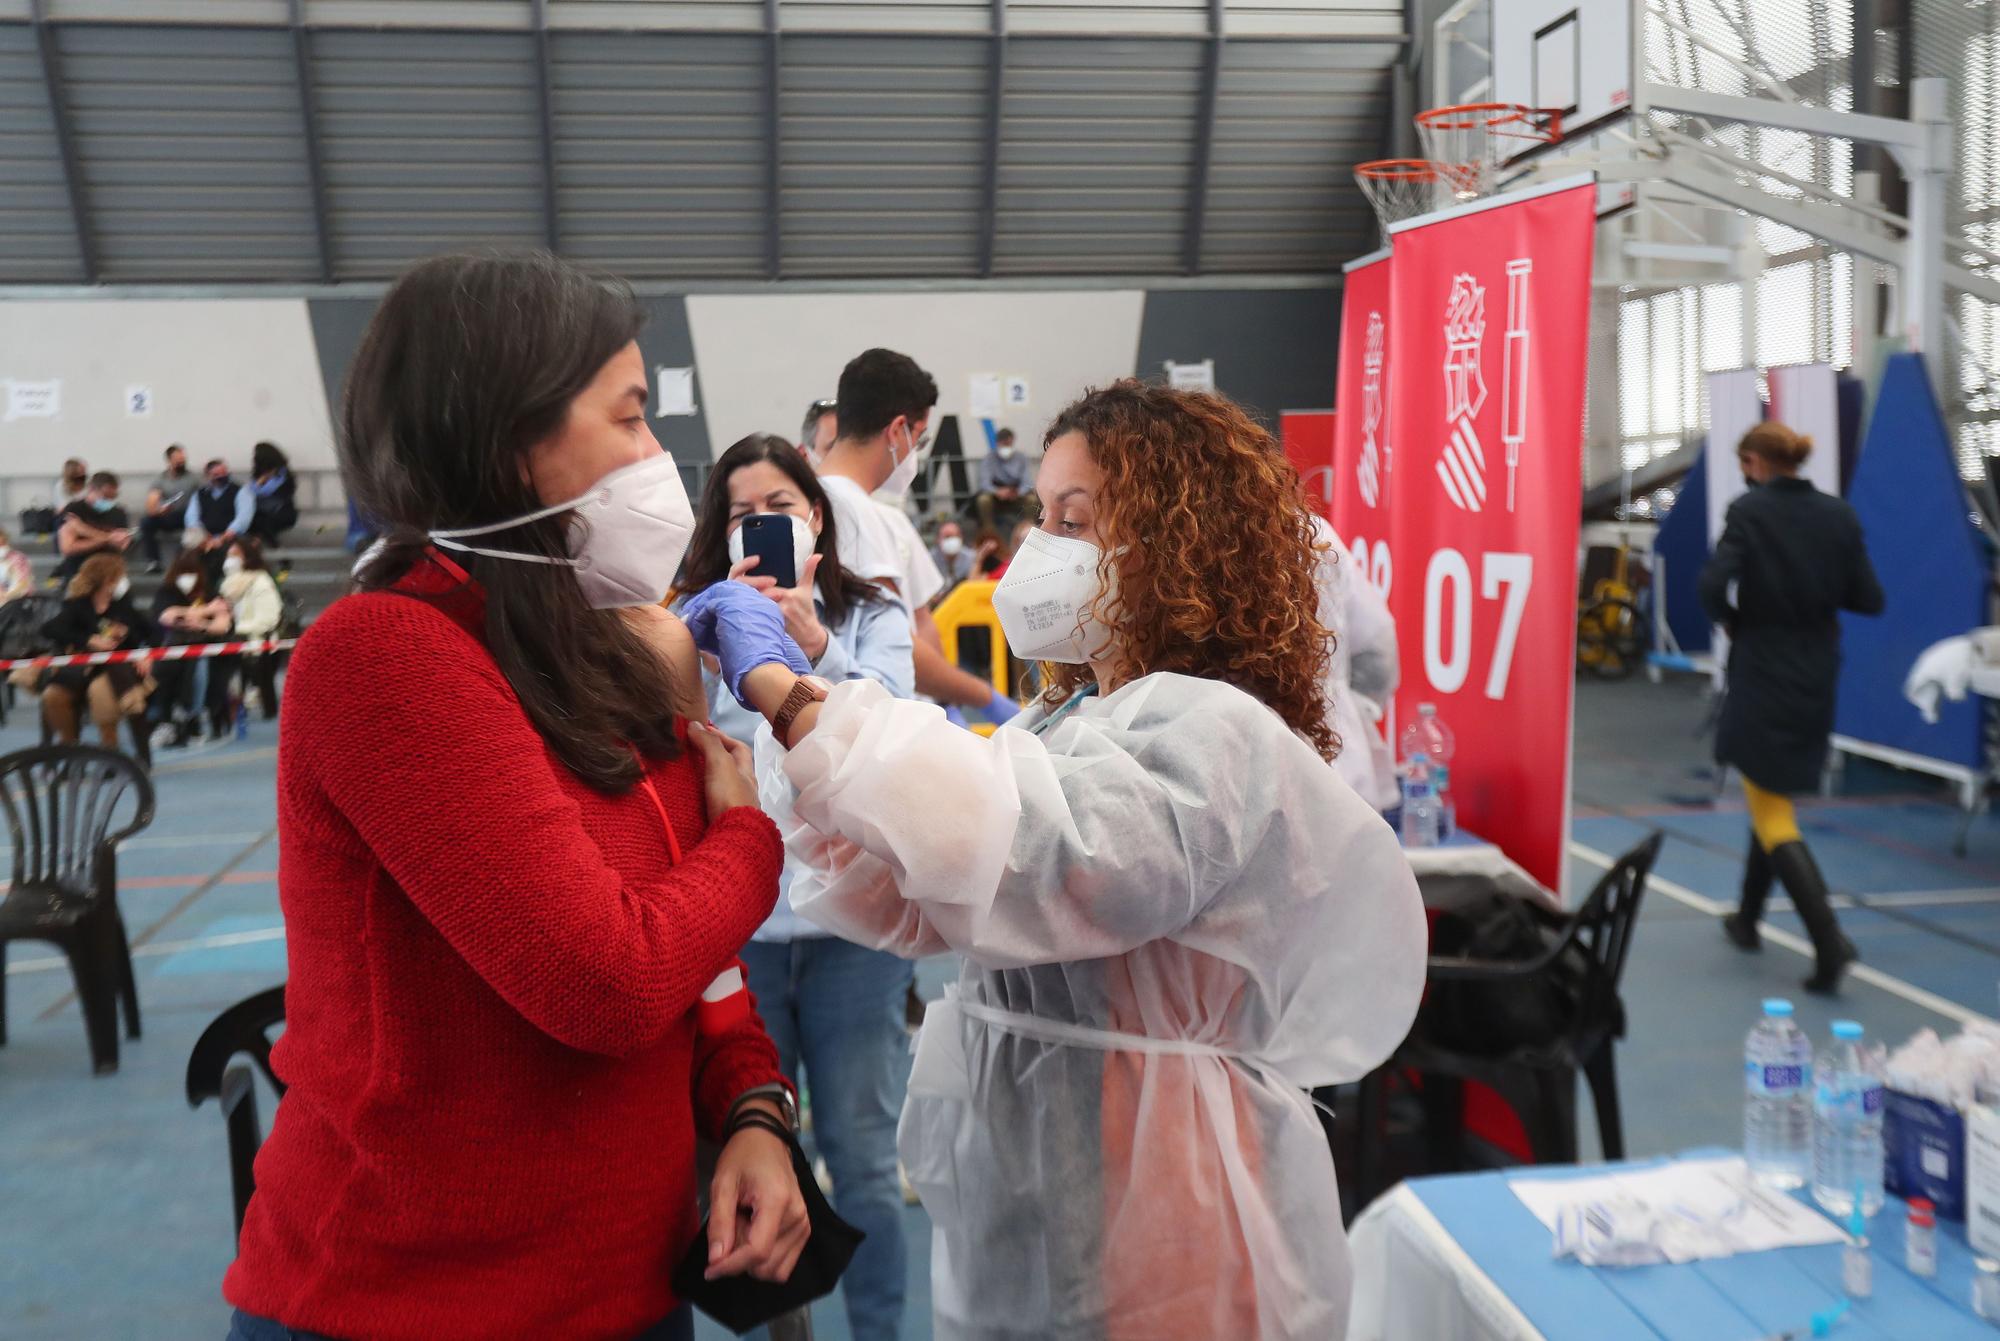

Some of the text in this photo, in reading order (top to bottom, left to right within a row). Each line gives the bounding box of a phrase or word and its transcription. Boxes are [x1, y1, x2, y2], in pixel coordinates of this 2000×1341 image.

[131, 393, 147, 414] 2
[1012, 384, 1025, 402] 2
[1423, 547, 1534, 700] 07
